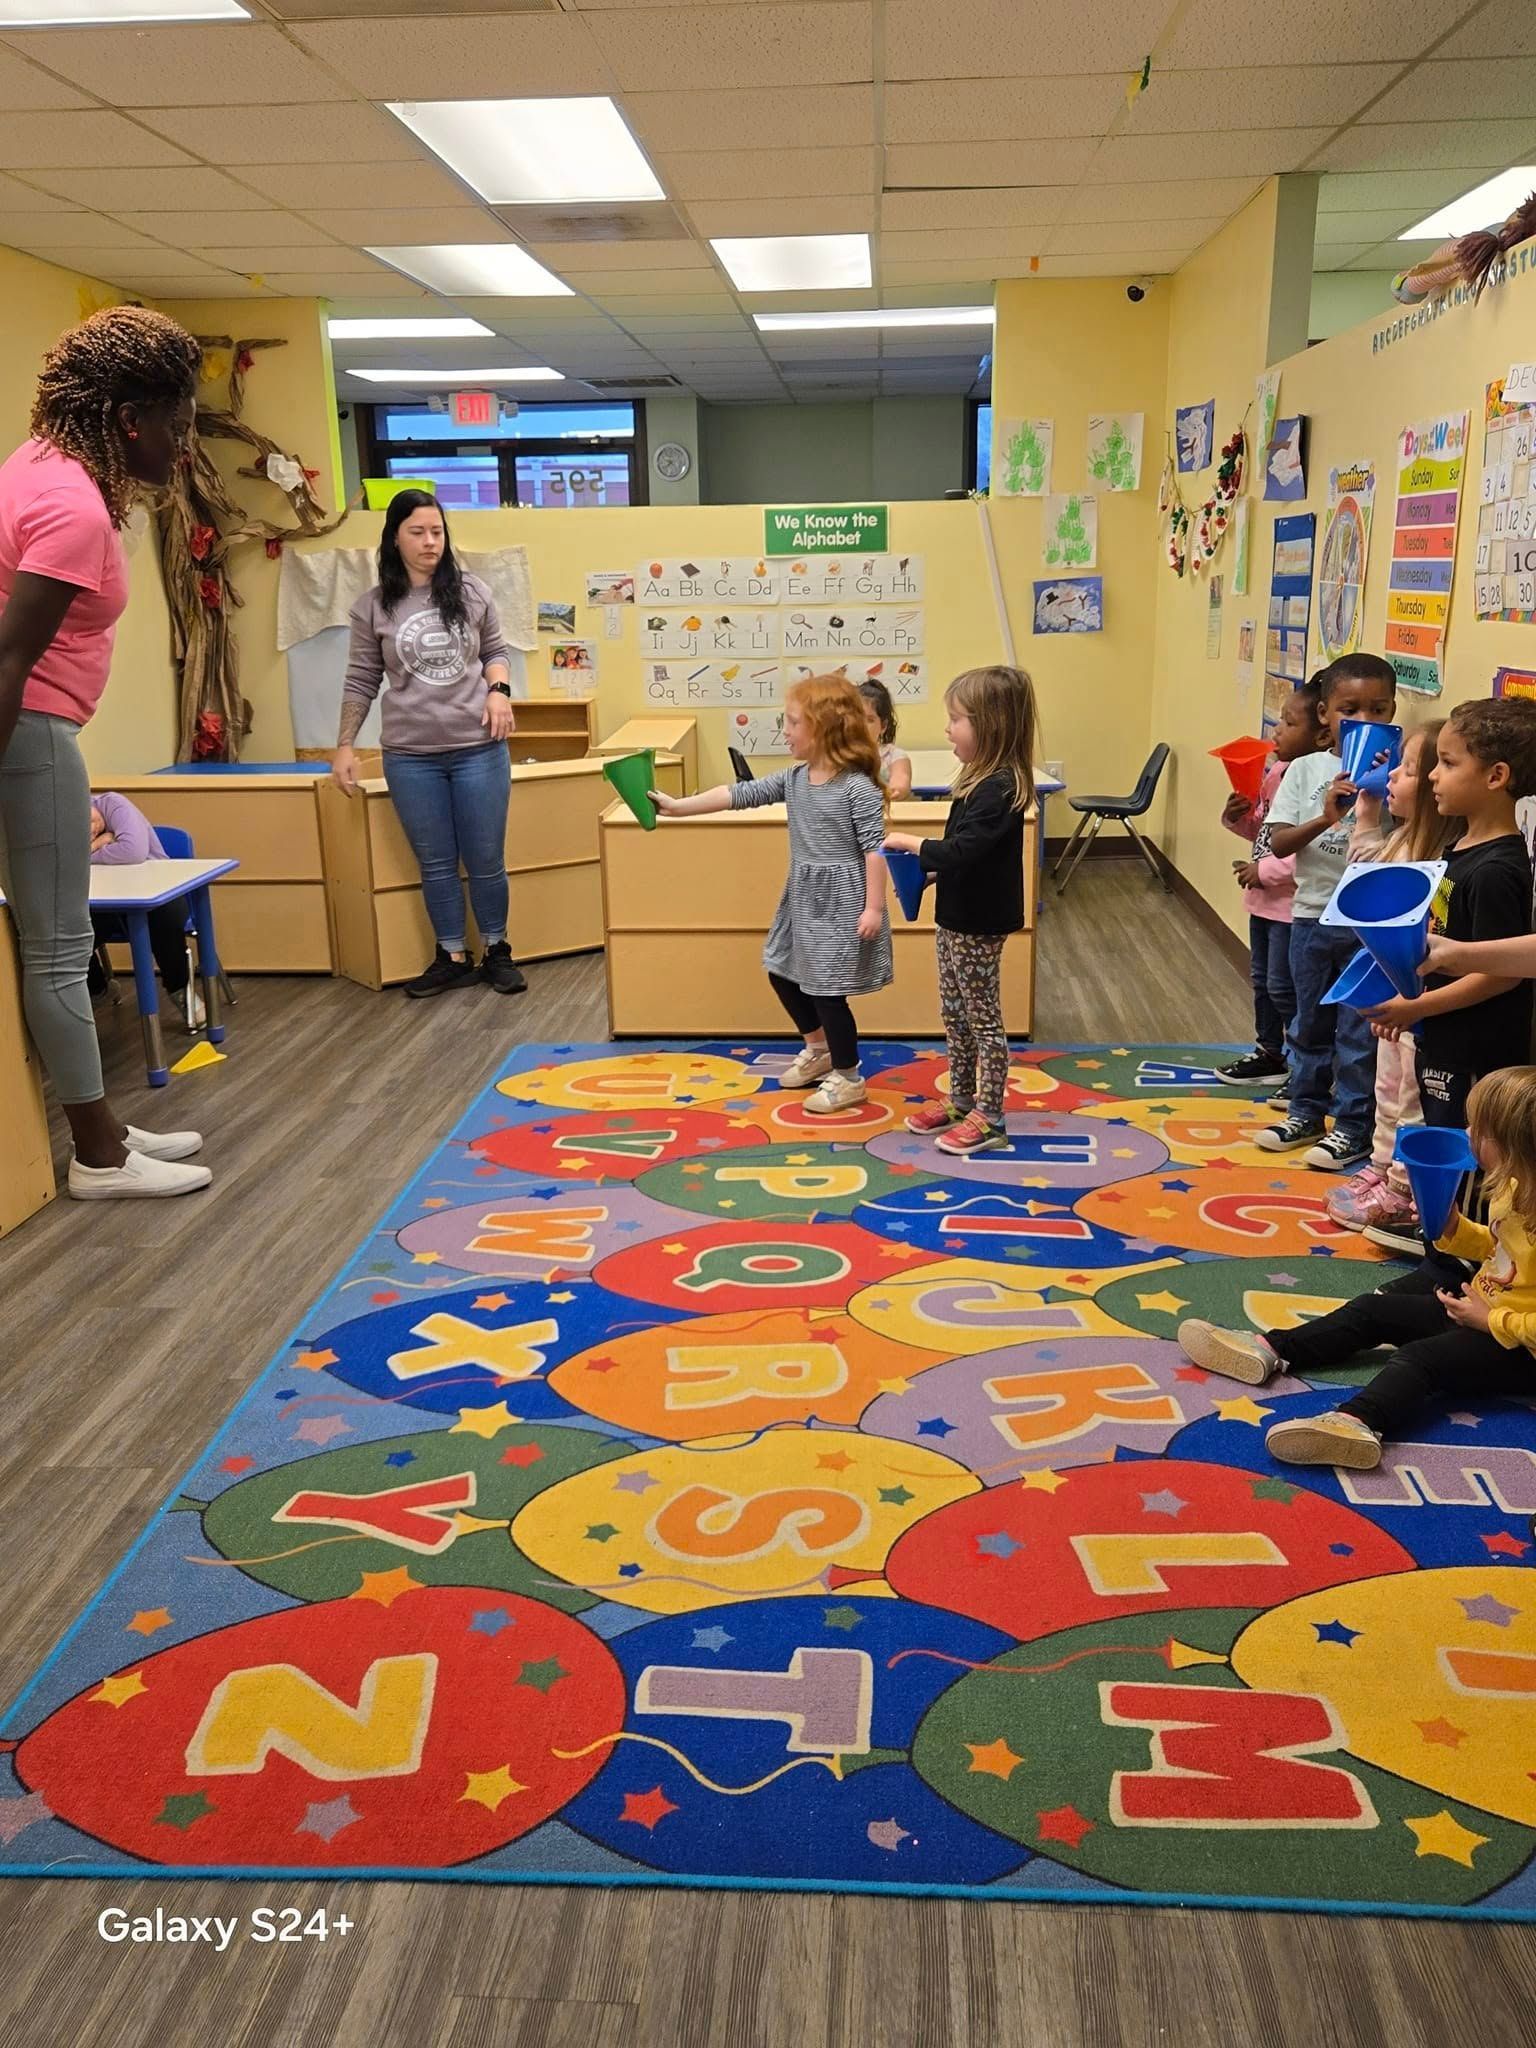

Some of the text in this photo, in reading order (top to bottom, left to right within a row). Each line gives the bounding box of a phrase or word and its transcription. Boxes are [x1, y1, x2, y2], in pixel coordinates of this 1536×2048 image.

[1404, 430, 1430, 459] Days
[1517, 437, 1528, 457] 26
[1410, 467, 1434, 488] Sunday
[1485, 472, 1506, 498] 3 4
[774, 511, 878, 530] We Know the
[1406, 502, 1432, 520] Monday
[1496, 512, 1503, 532] 11
[1508, 510, 1519, 531] 12
[792, 530, 862, 550] Alphabet
[1403, 534, 1429, 553] Tuesday
[1477, 545, 1488, 565] 17
[644, 579, 772, 597] Aa Bb Cc Dd
[788, 576, 917, 601] Ee Ff Gg Hh
[1519, 582, 1532, 602] 30
[1396, 597, 1427, 620] Thursday
[679, 633, 698, 656] Jj
[713, 632, 737, 649] Kk
[785, 629, 917, 652] Mm Nn Oo Pp
[1398, 628, 1419, 646] Friday
[1393, 659, 1420, 683] Saturday
[648, 681, 774, 705] Qq Rr Ss Tt
[897, 678, 921, 696] Xx
[736, 730, 758, 753] Yy
[1318, 841, 1344, 856] RIDE
[552, 1129, 678, 1161] V
[715, 1166, 868, 1199] P
[463, 1206, 609, 1263] W
[672, 1241, 852, 1293] Q
[911, 1284, 1090, 1330] J
[387, 1312, 560, 1381] X
[664, 1343, 849, 1411] R
[983, 1363, 1187, 1451] K
[272, 1470, 478, 1555] Y
[643, 1482, 873, 1562] S
[1069, 1532, 1290, 1596] L
[635, 1647, 874, 1754] T
[185, 1653, 438, 1781] Z
[1098, 1681, 1381, 1829] M
